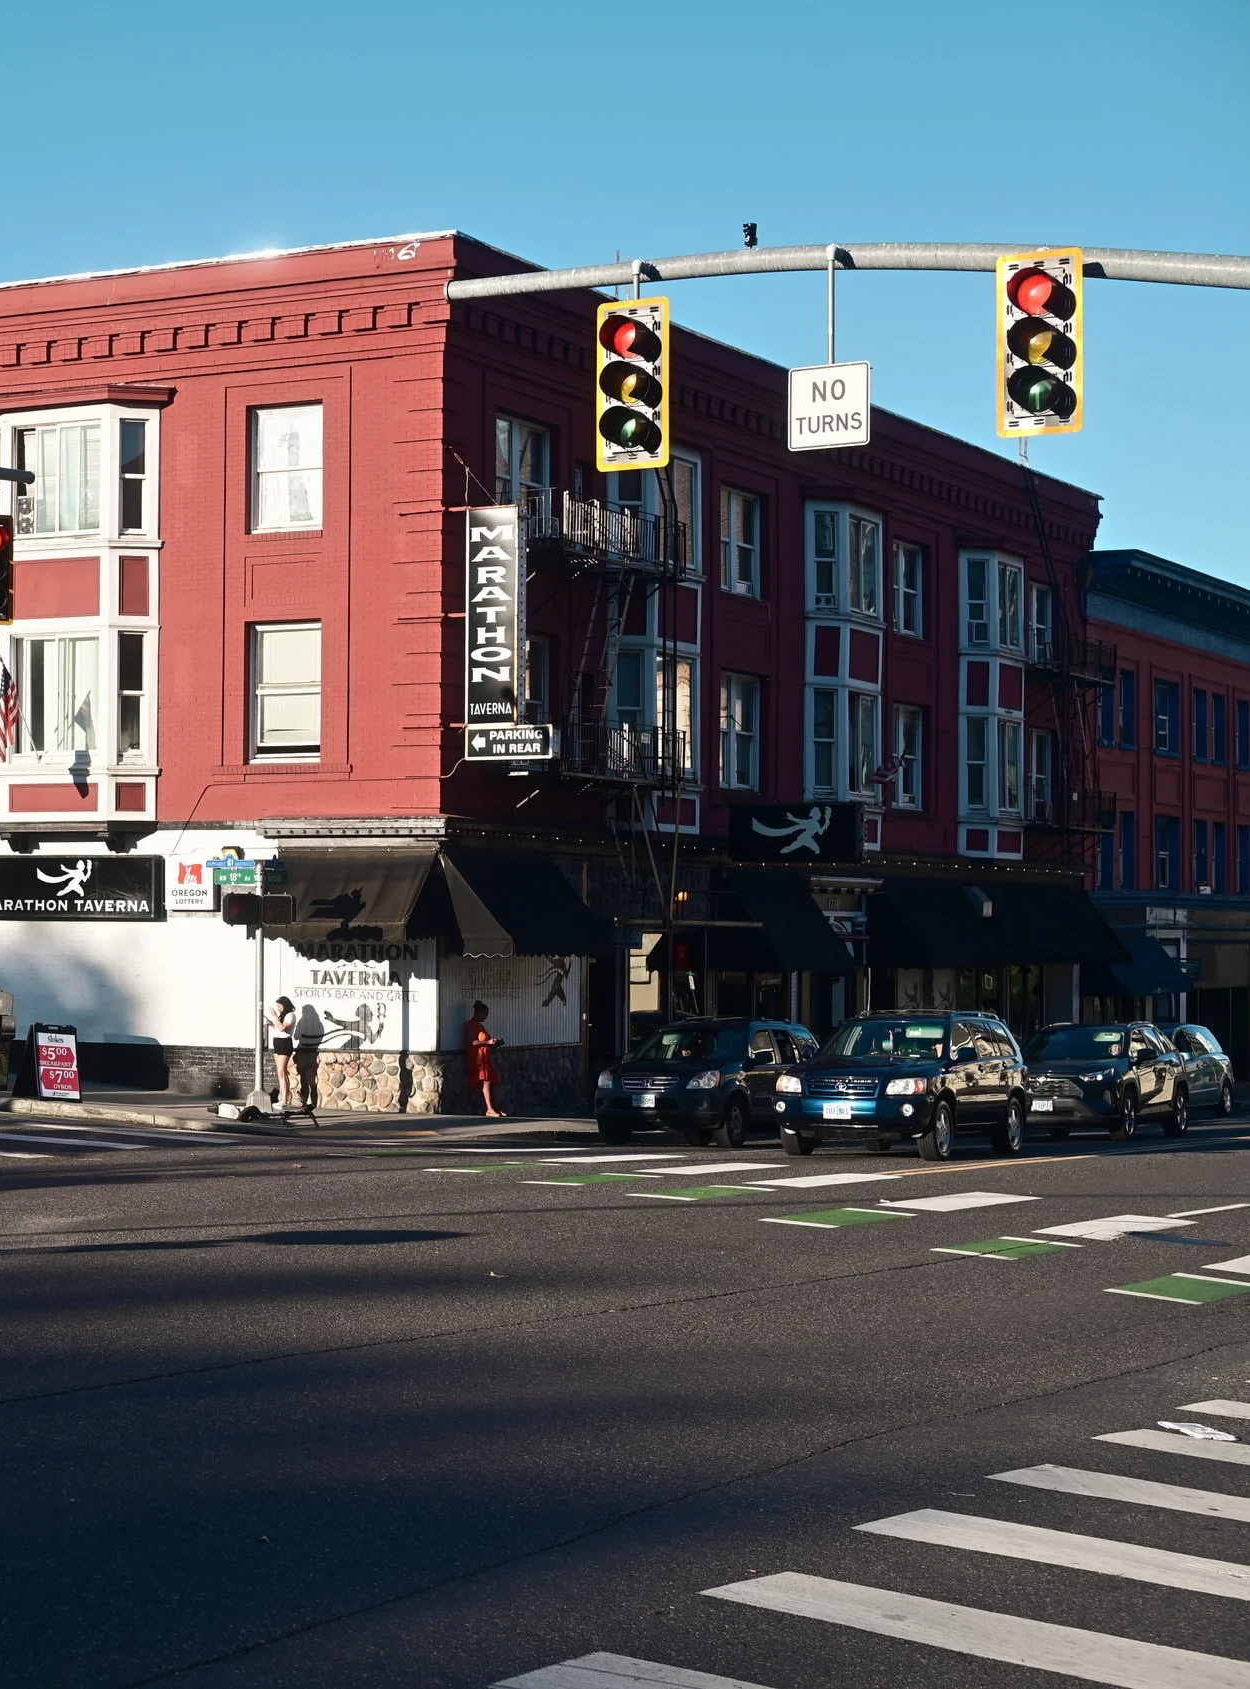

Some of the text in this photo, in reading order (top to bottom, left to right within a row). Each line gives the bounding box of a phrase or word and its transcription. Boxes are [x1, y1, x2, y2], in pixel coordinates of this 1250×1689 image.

[812, 379, 846, 402] NO
[795, 411, 862, 435] TURNS
[469, 524, 514, 683] MARATHON
[469, 702, 512, 716] TAVERNA
[489, 729, 543, 740] PARKING
[492, 742, 541, 754] IN REAR
[171, 889, 208, 897] OREGON
[74, 899, 150, 912] TAVERNA
[296, 943, 419, 960] MARATHON
[310, 969, 403, 987] TAVERNA
[293, 988, 419, 1003] SPORTS BAR AND GRILL
[39, 1060, 72, 1068] BREAKFAST
